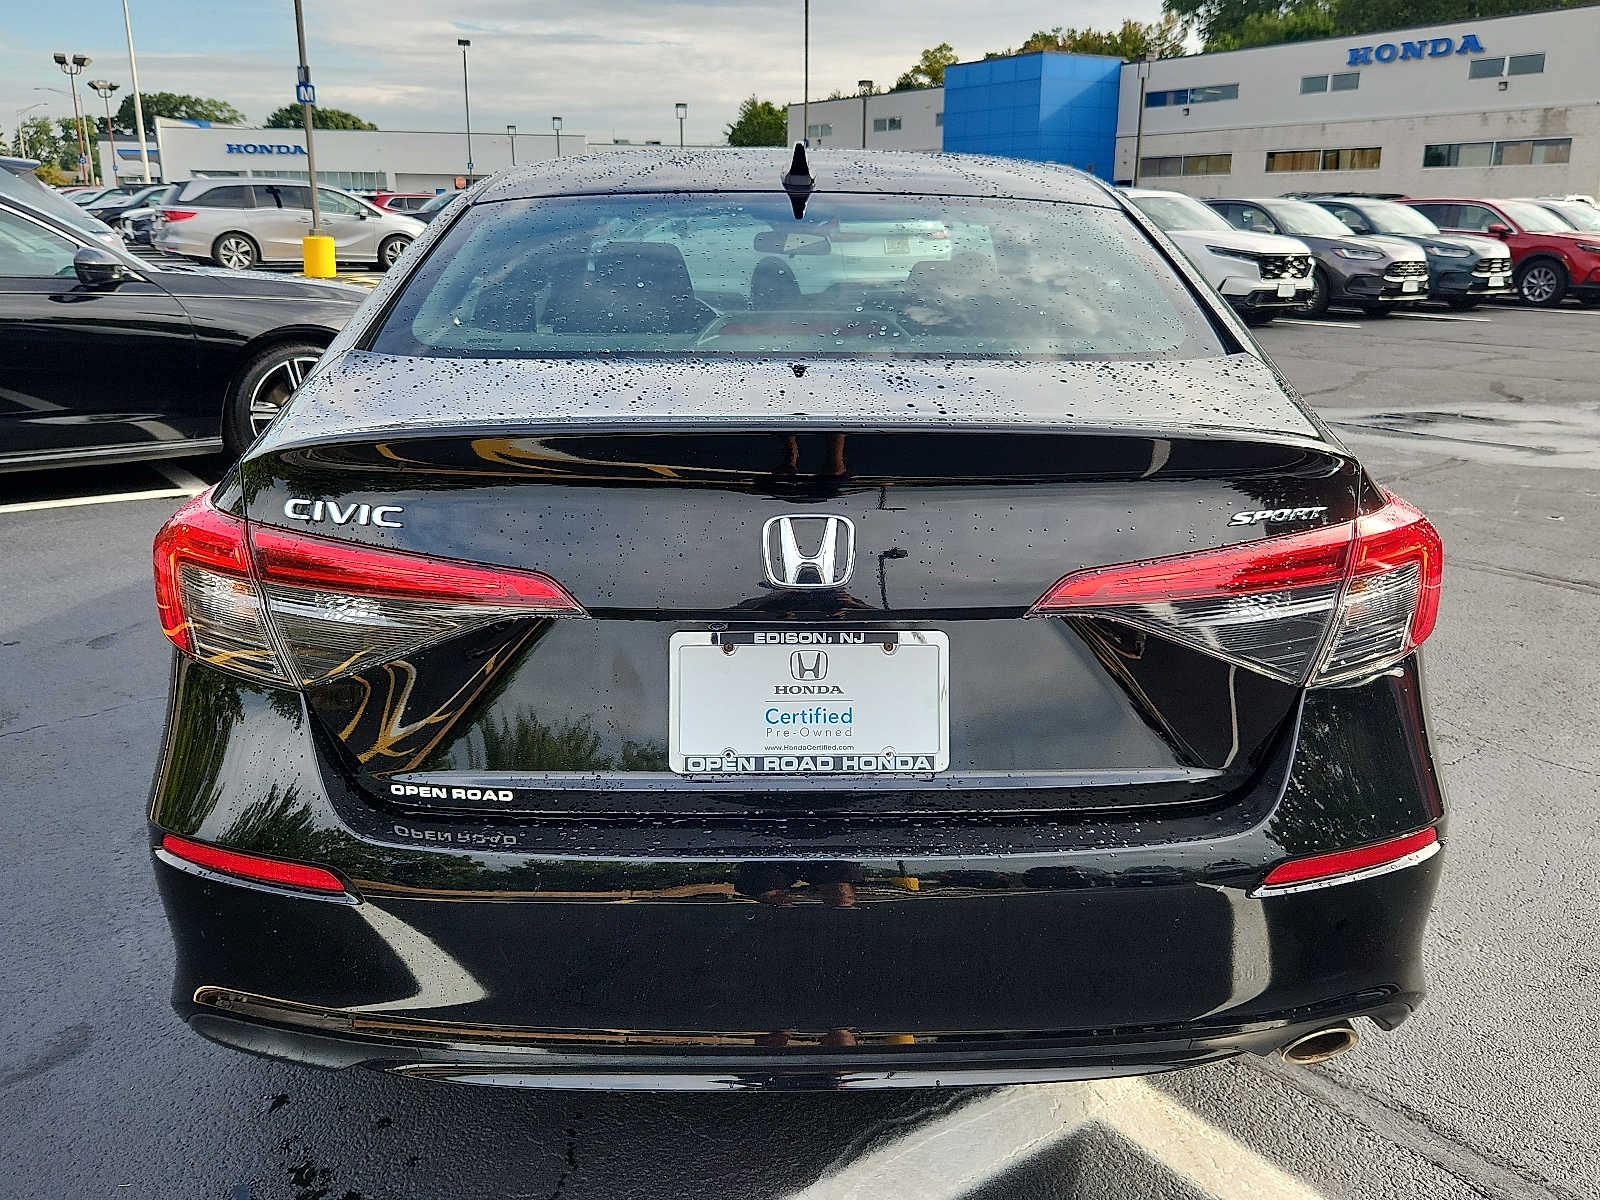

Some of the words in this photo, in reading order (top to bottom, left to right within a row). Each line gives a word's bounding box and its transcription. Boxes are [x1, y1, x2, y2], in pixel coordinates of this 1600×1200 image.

[1346, 33, 1484, 66] HONDA
[226, 143, 308, 155] HONDA
[284, 498, 404, 527] CIVIC
[1227, 506, 1328, 526] SPORT
[753, 632, 833, 644] EDISON,
[839, 632, 865, 644] NJ
[773, 685, 844, 695] HONDA
[765, 706, 853, 725] Certified
[766, 727, 852, 737] Pre-Owned
[687, 756, 756, 772] OPEN
[763, 756, 834, 771] ROAD
[842, 755, 933, 771] HONDA
[390, 784, 448, 799] OPEN
[451, 788, 514, 802] ROAD
